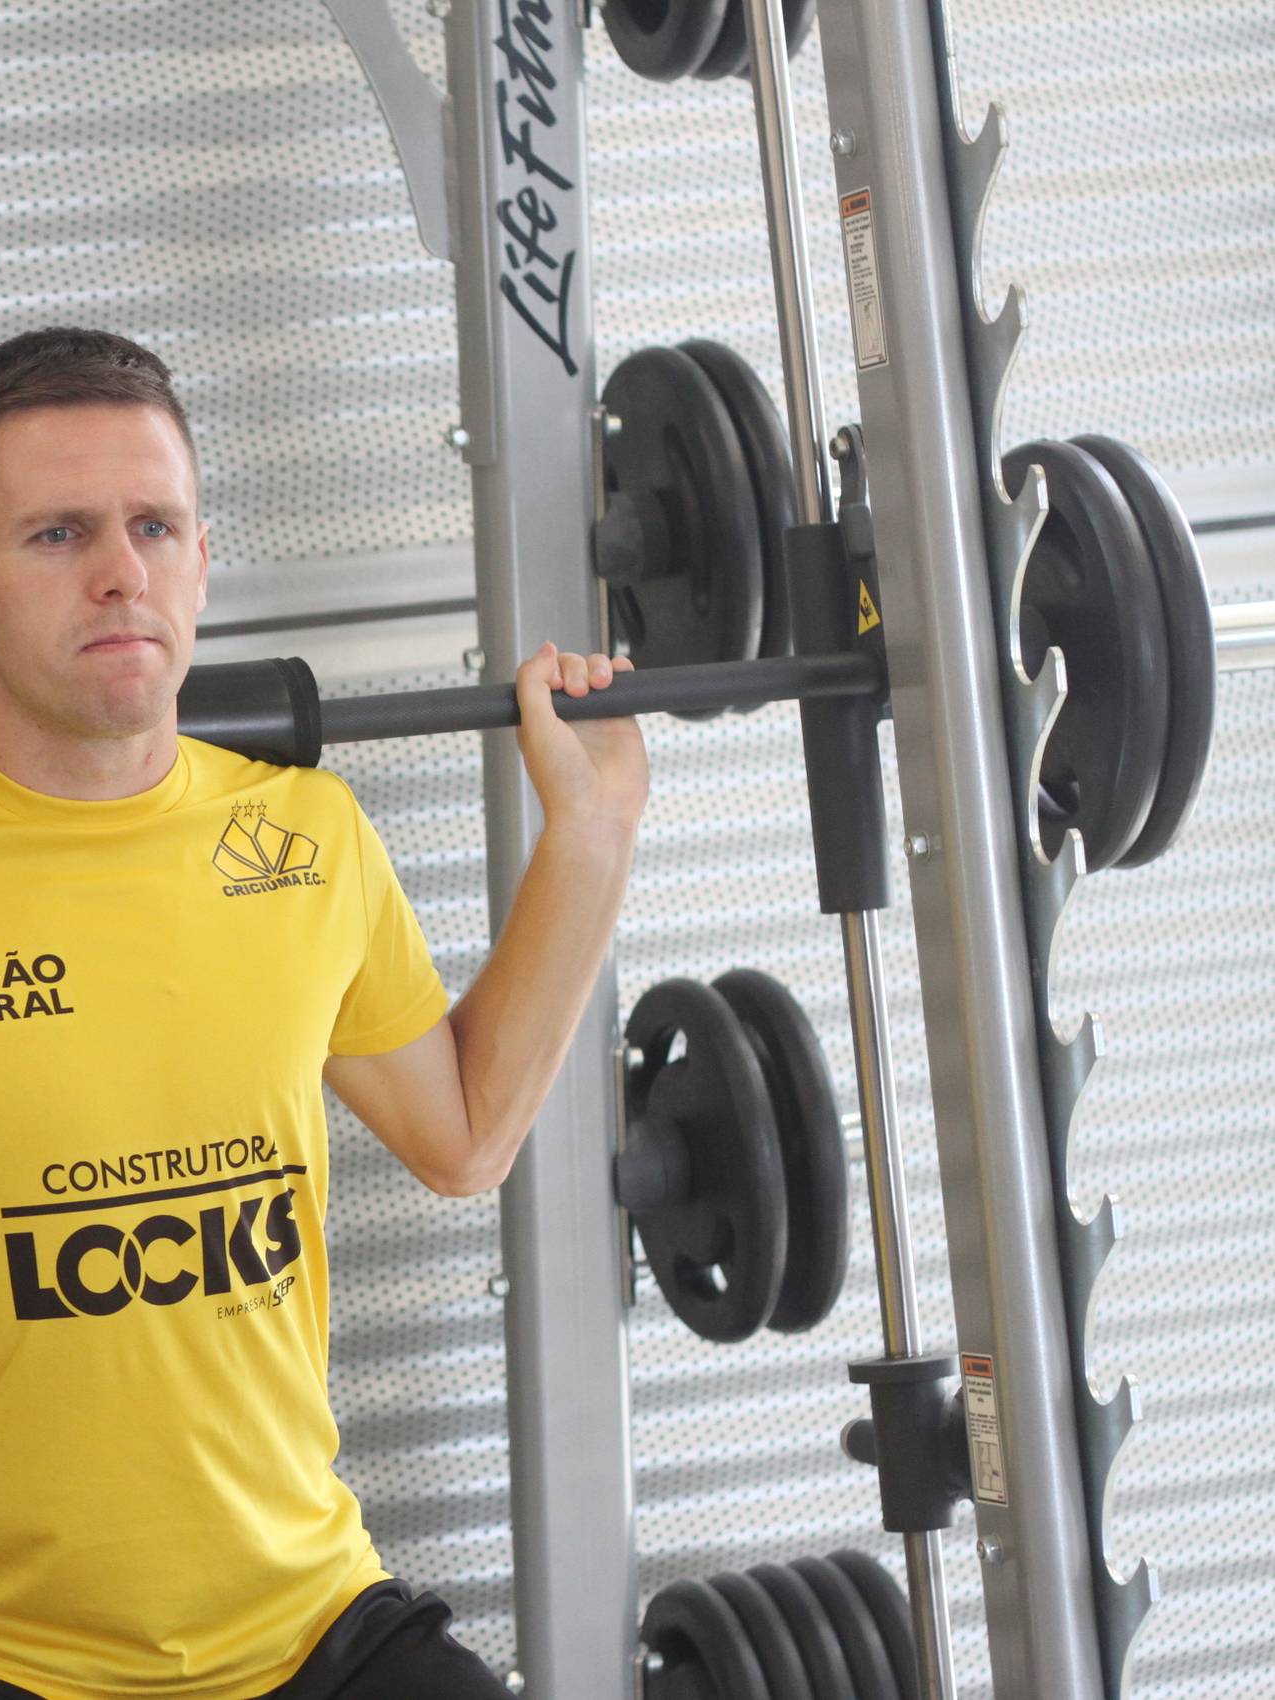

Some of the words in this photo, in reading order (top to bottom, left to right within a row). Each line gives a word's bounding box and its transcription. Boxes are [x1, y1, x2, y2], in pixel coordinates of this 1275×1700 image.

[494, 0, 574, 191] Fitn
[497, 185, 579, 377] Life
[222, 873, 302, 897] CRICIÚMA
[303, 872, 327, 886] E.C.
[42, 1135, 278, 1194] CONSTRUTORA
[4, 1187, 302, 1321] LOCKS
